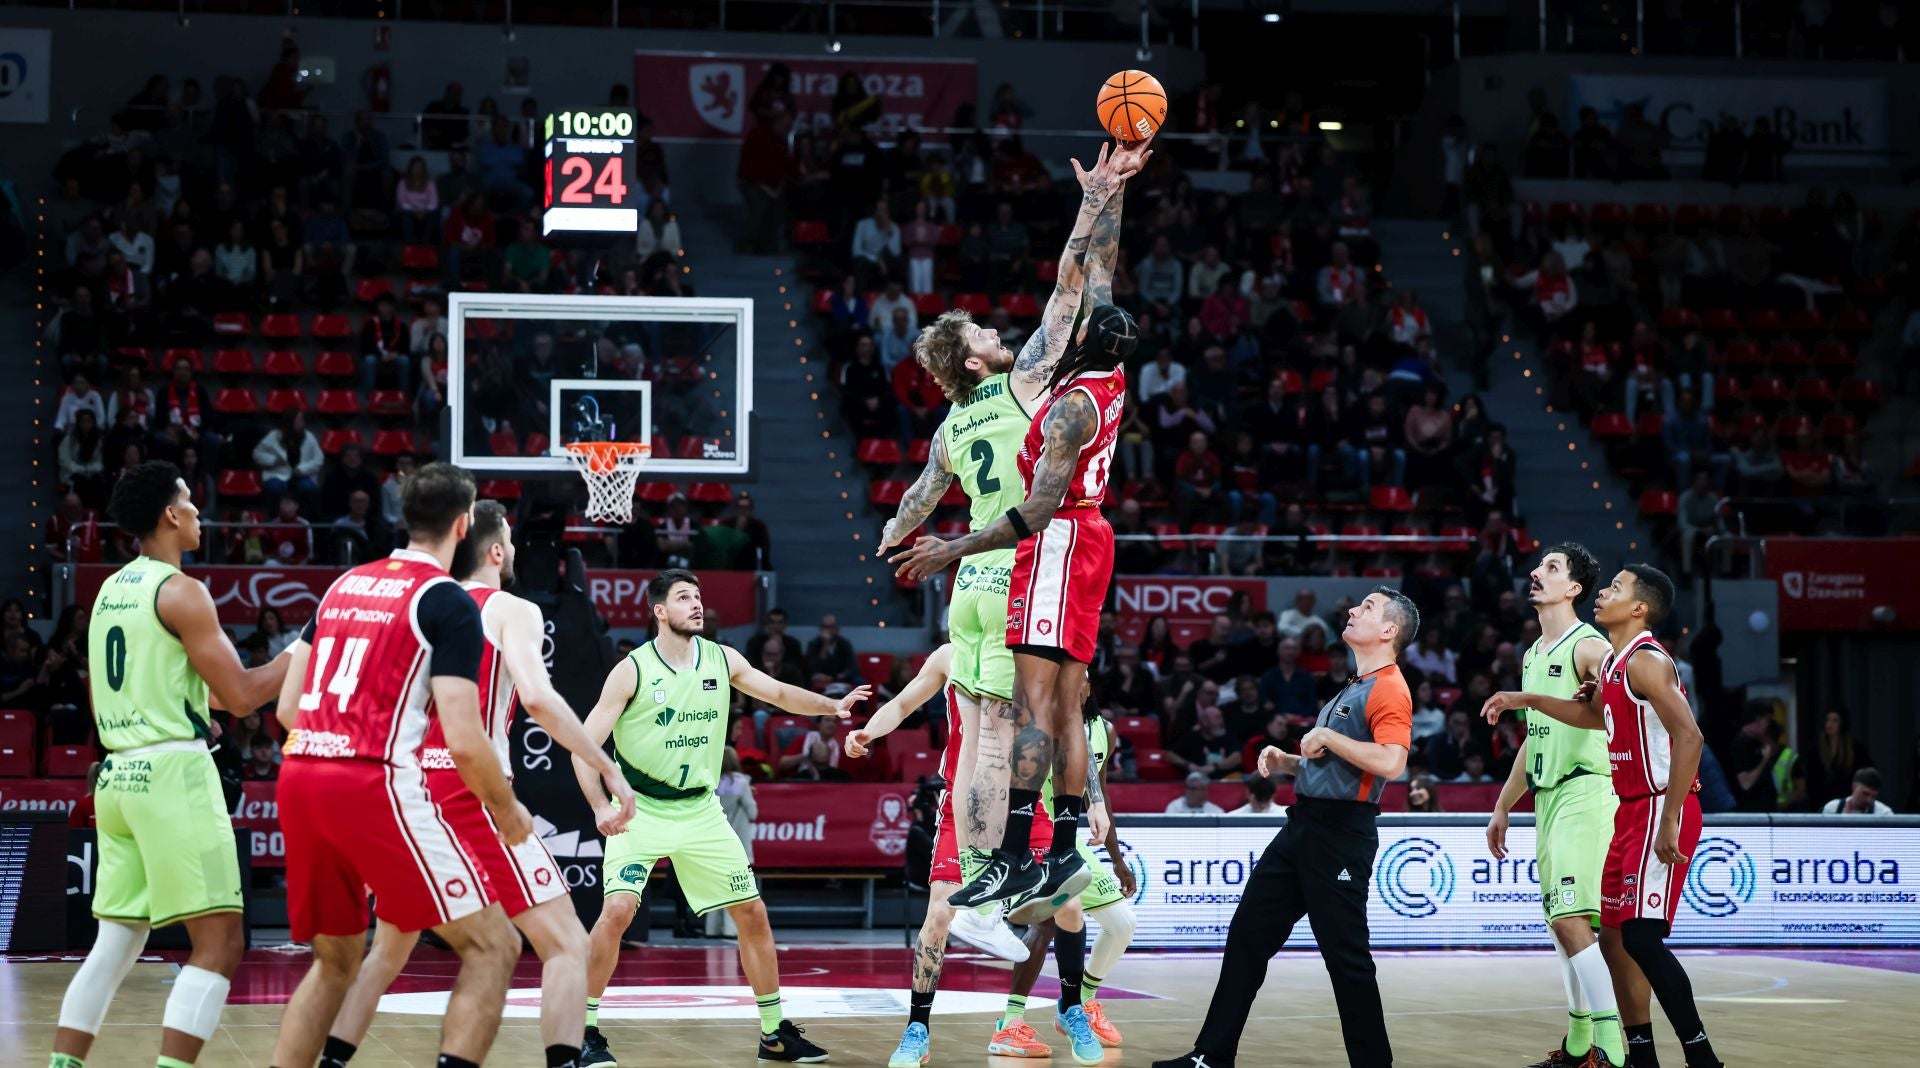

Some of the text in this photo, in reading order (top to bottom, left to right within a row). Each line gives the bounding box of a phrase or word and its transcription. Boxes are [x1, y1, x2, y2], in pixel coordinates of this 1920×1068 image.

[558, 111, 633, 136] 10:00
[1661, 102, 1864, 145] CaBank
[560, 156, 627, 204] 24
[957, 383, 1003, 409] OWSKI
[971, 440, 1001, 495] 2
[991, 577, 1010, 588] SOL
[106, 625, 127, 692] 0
[298, 637, 371, 713] 14
[677, 708, 719, 723] Unicaja
[130, 773, 152, 784] SOL
[678, 764, 690, 788] 1
[1771, 851, 1899, 884] arroba
